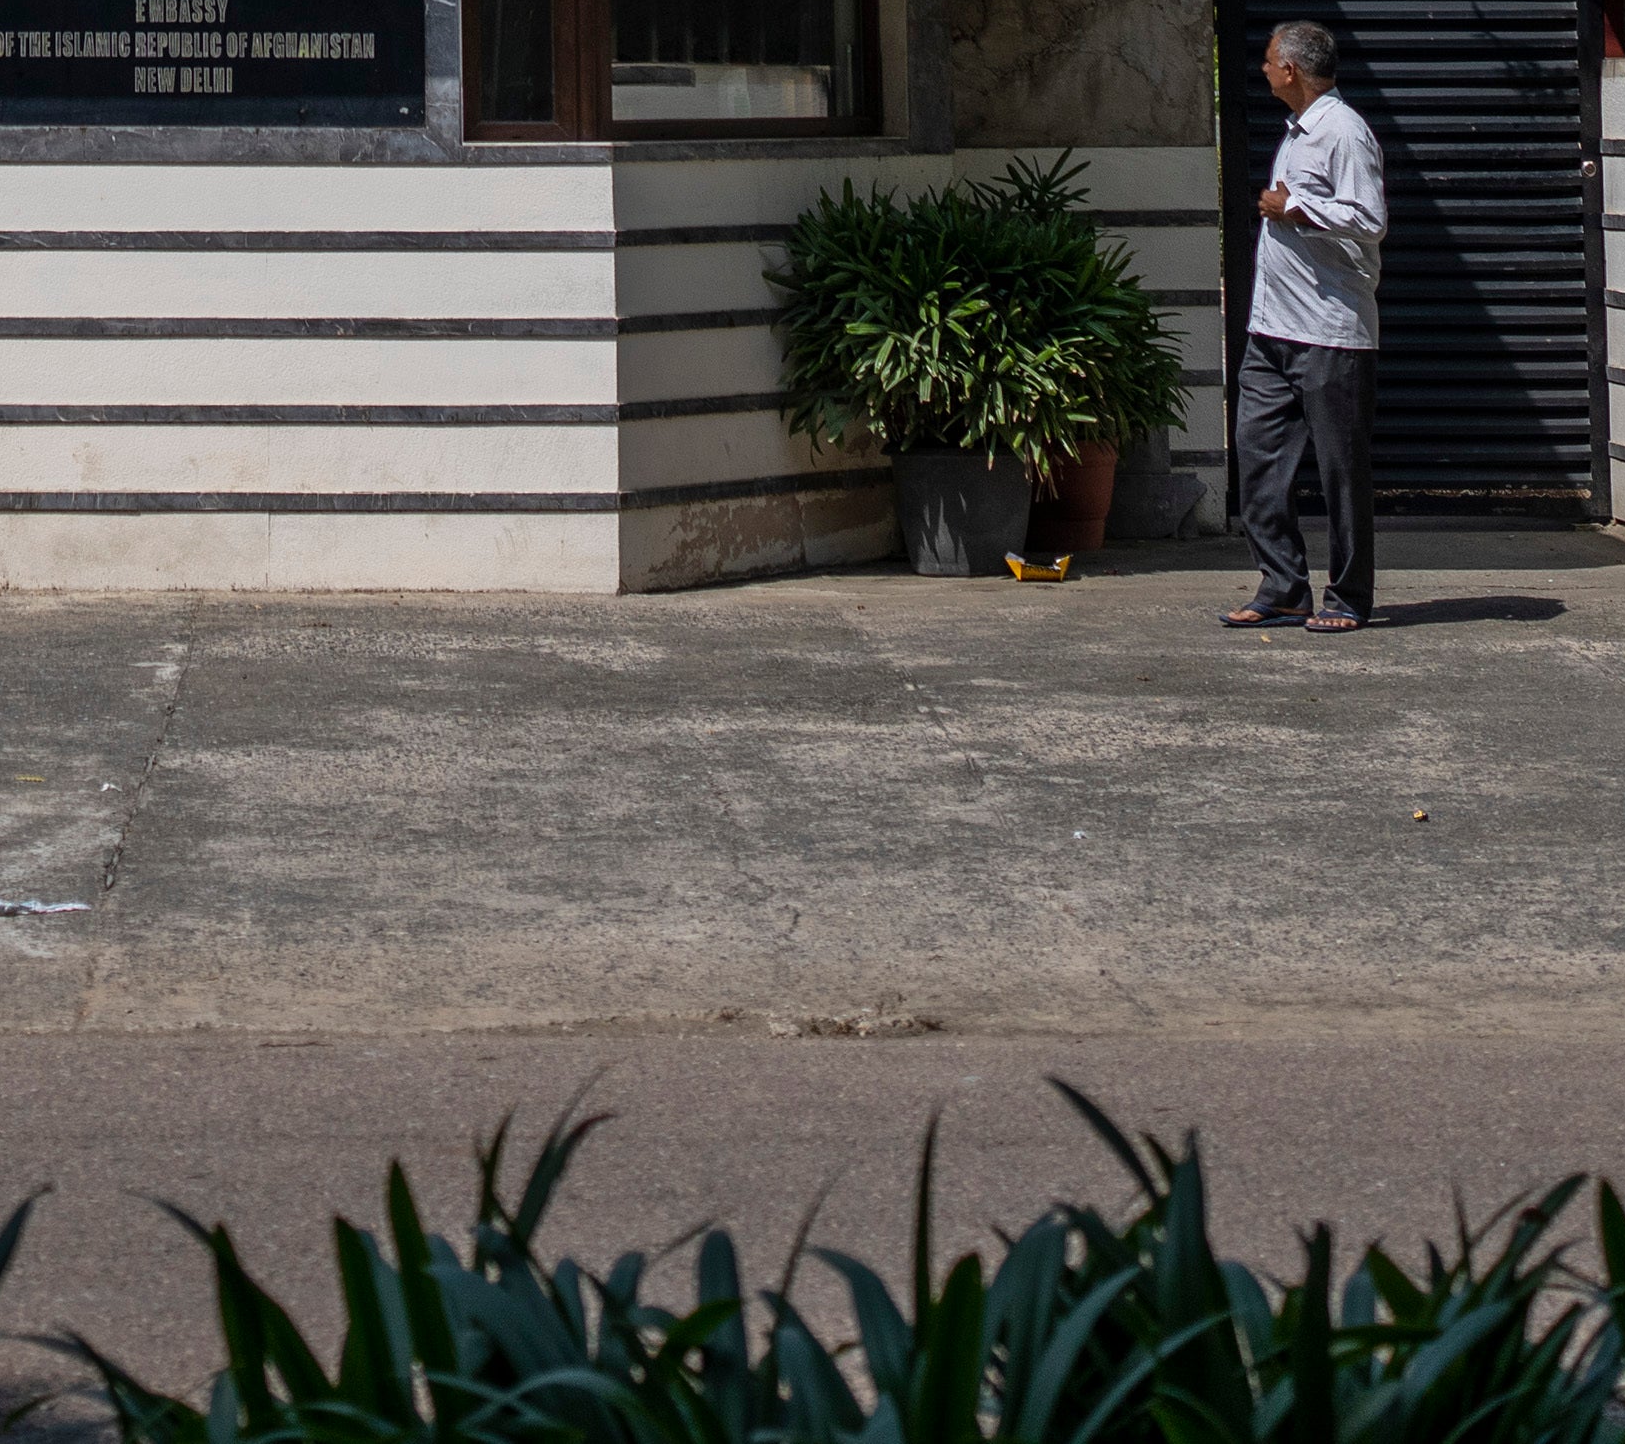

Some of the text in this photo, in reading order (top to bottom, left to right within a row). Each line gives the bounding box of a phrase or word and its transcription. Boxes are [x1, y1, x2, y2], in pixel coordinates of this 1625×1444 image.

[18, 31, 50, 58] THE
[55, 31, 130, 59] ISLAMIC
[135, 31, 222, 59] REPUBLIC
[226, 32, 248, 59] OF
[251, 32, 375, 60] AFGHANISTAN
[134, 66, 234, 94] NEW DELHI
